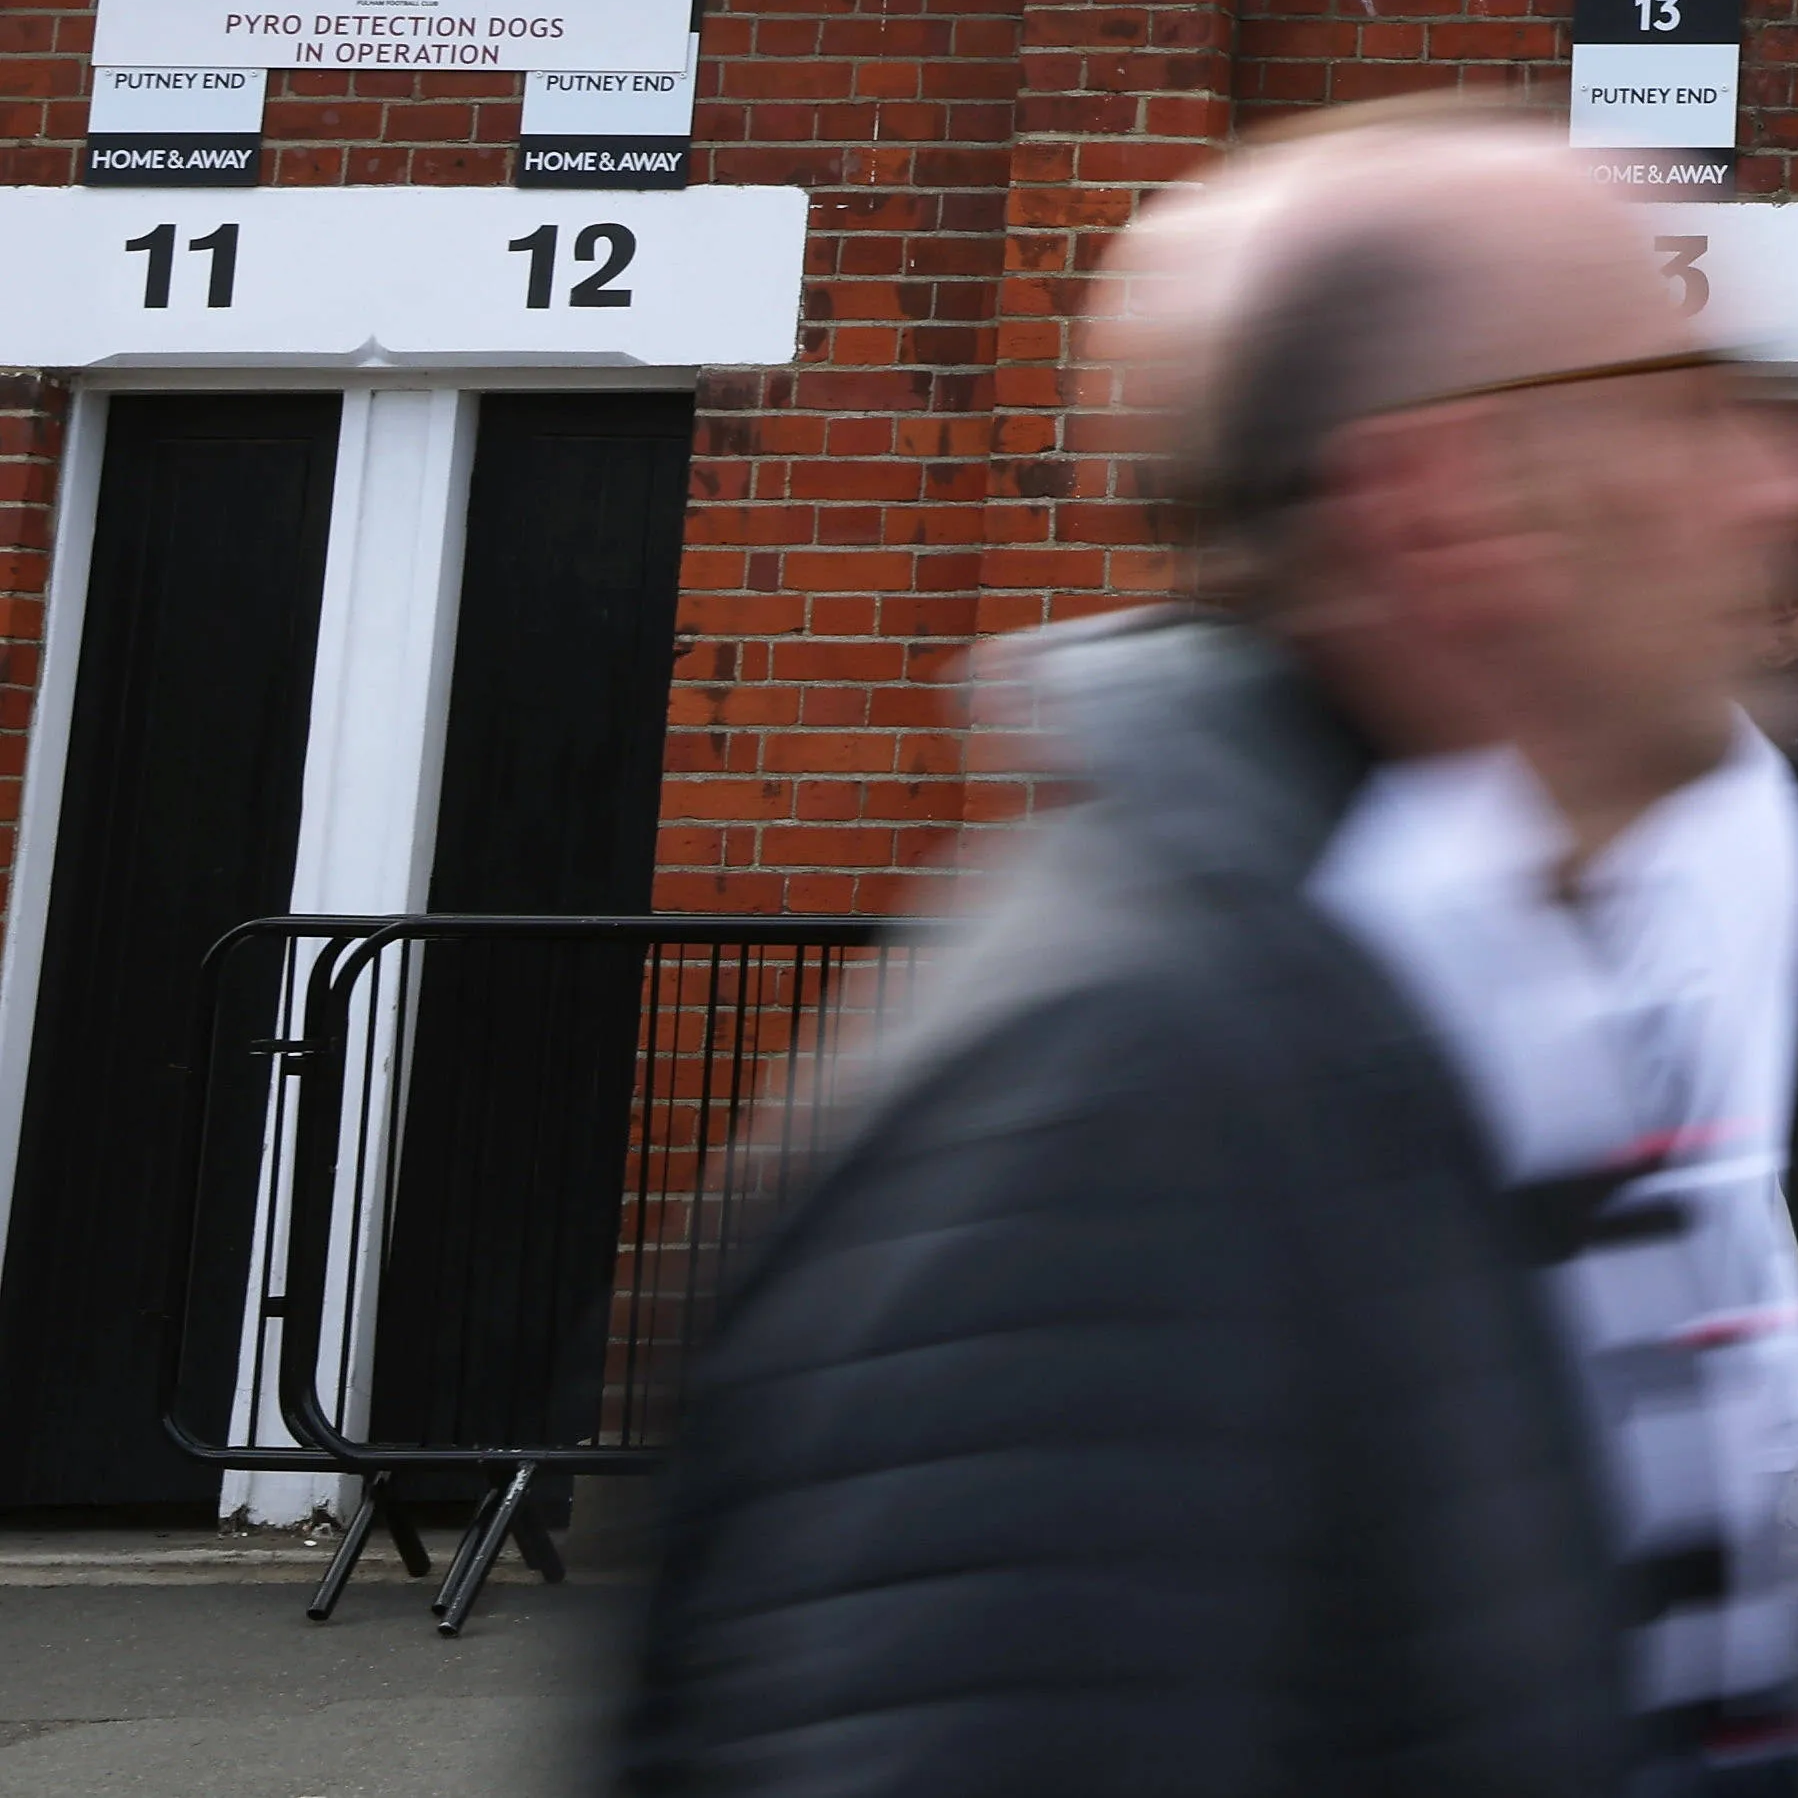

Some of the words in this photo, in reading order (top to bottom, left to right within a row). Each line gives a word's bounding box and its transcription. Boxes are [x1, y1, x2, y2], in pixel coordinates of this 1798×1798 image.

[225, 14, 302, 35] PYRO
[315, 15, 476, 37] DETECTION
[489, 17, 564, 39] DOGS
[296, 42, 323, 63] IN
[335, 42, 499, 65] OPERATION
[114, 73, 197, 89] PUTNEY
[203, 73, 245, 90] END
[547, 75, 627, 92] PUTNEY
[633, 76, 674, 92] END
[1591, 87, 1670, 104] PUTNEY
[1677, 87, 1717, 104] END
[124, 223, 240, 309] 11
[507, 222, 637, 310] 12
[1654, 235, 1709, 326] 3
